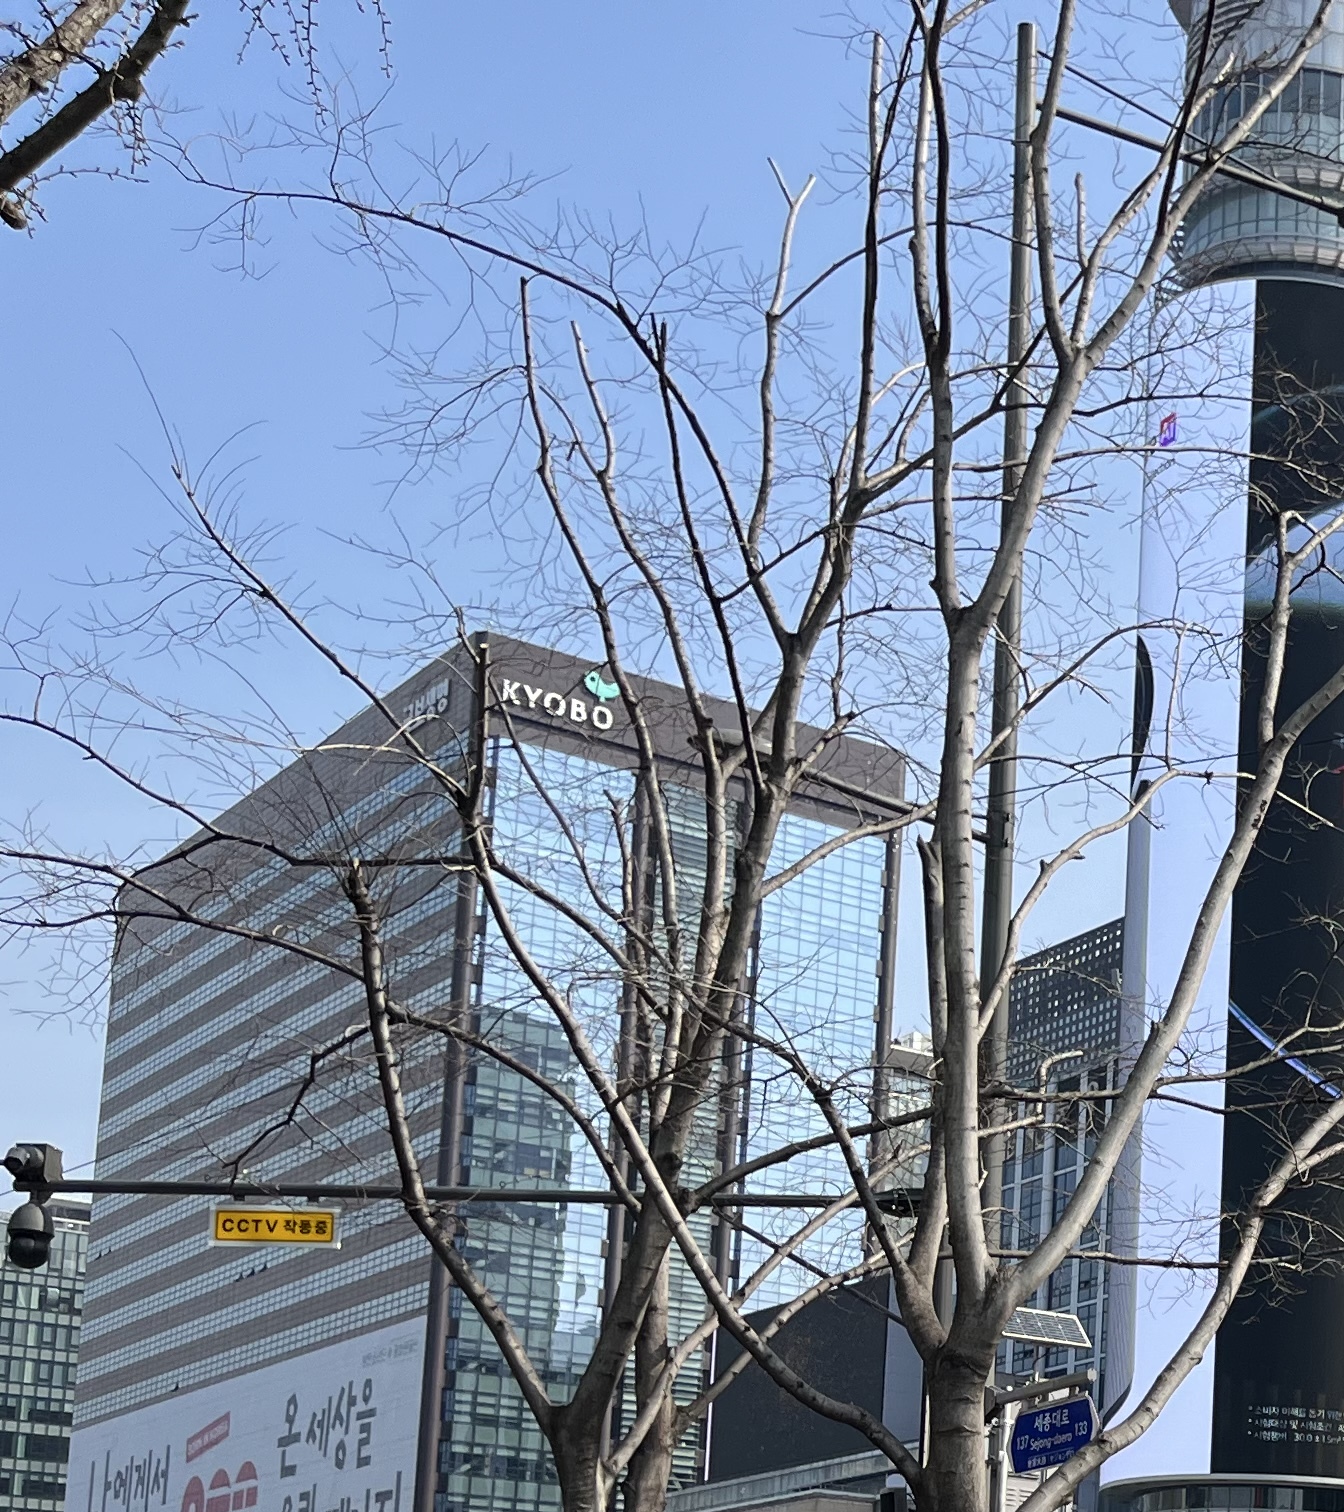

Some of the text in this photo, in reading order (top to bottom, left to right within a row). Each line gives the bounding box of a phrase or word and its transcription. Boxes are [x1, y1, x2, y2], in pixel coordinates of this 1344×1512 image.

[502, 678, 613, 730] KYOBO
[222, 1219, 278, 1233] CCTV
[305, 1377, 377, 1470] 세상을
[1034, 1409, 1070, 1432] 세종대로
